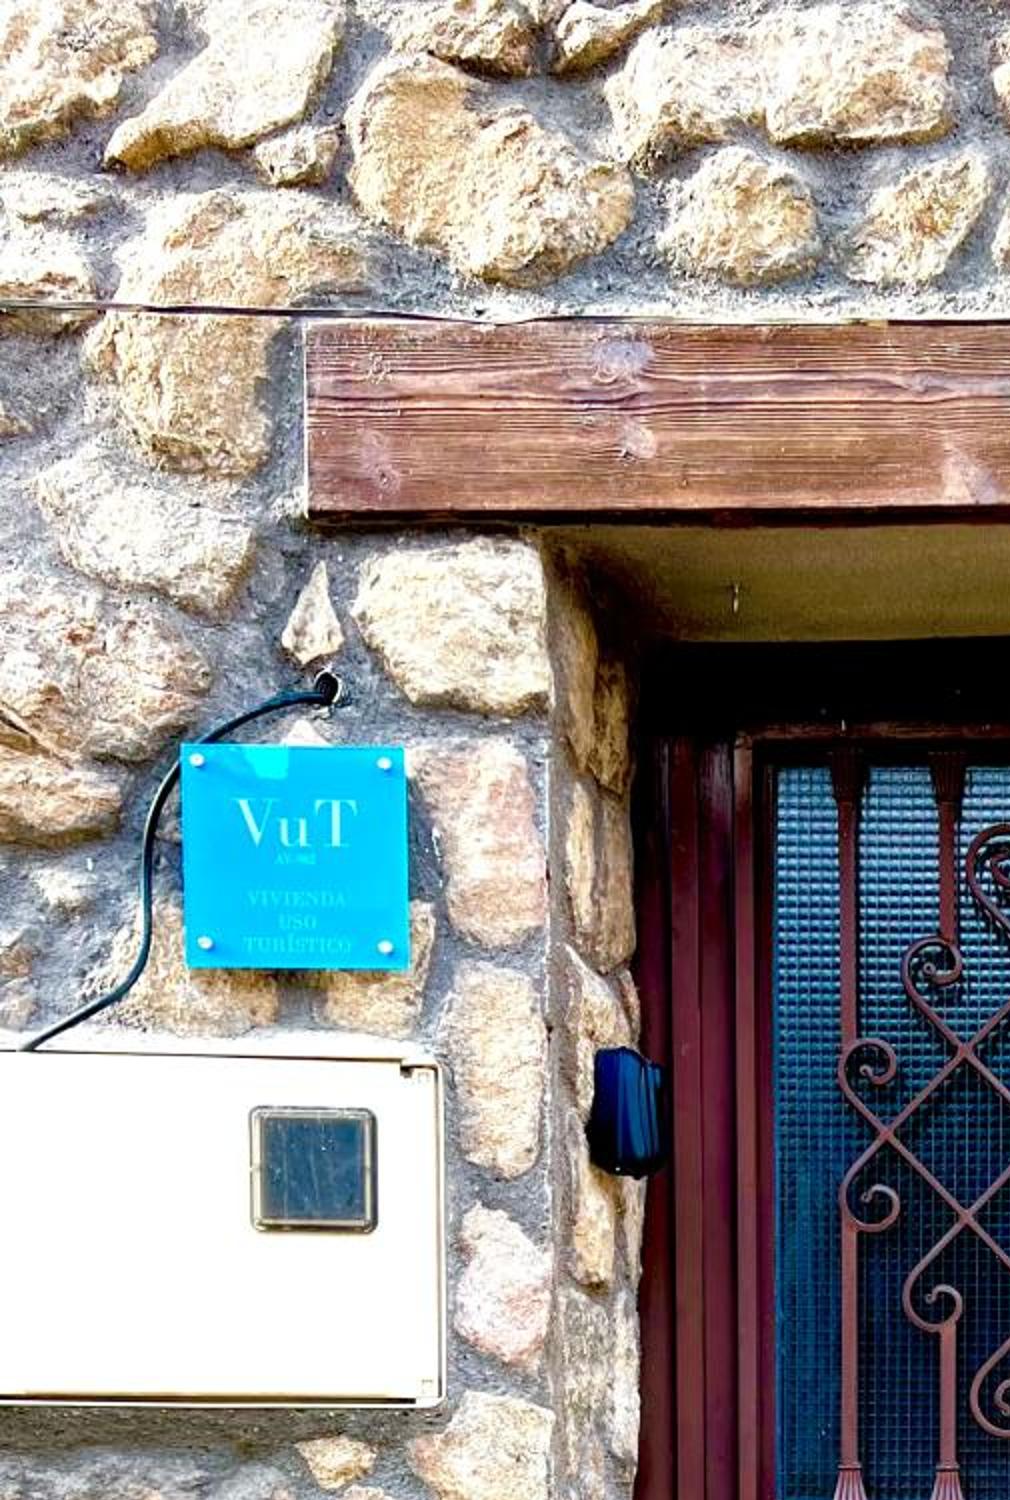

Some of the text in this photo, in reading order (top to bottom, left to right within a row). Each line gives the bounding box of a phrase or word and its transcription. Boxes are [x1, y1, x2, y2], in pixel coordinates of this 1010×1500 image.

[232, 798, 359, 848] VuT
[247, 891, 346, 907] VIVIENDA
[279, 914, 317, 929] USO
